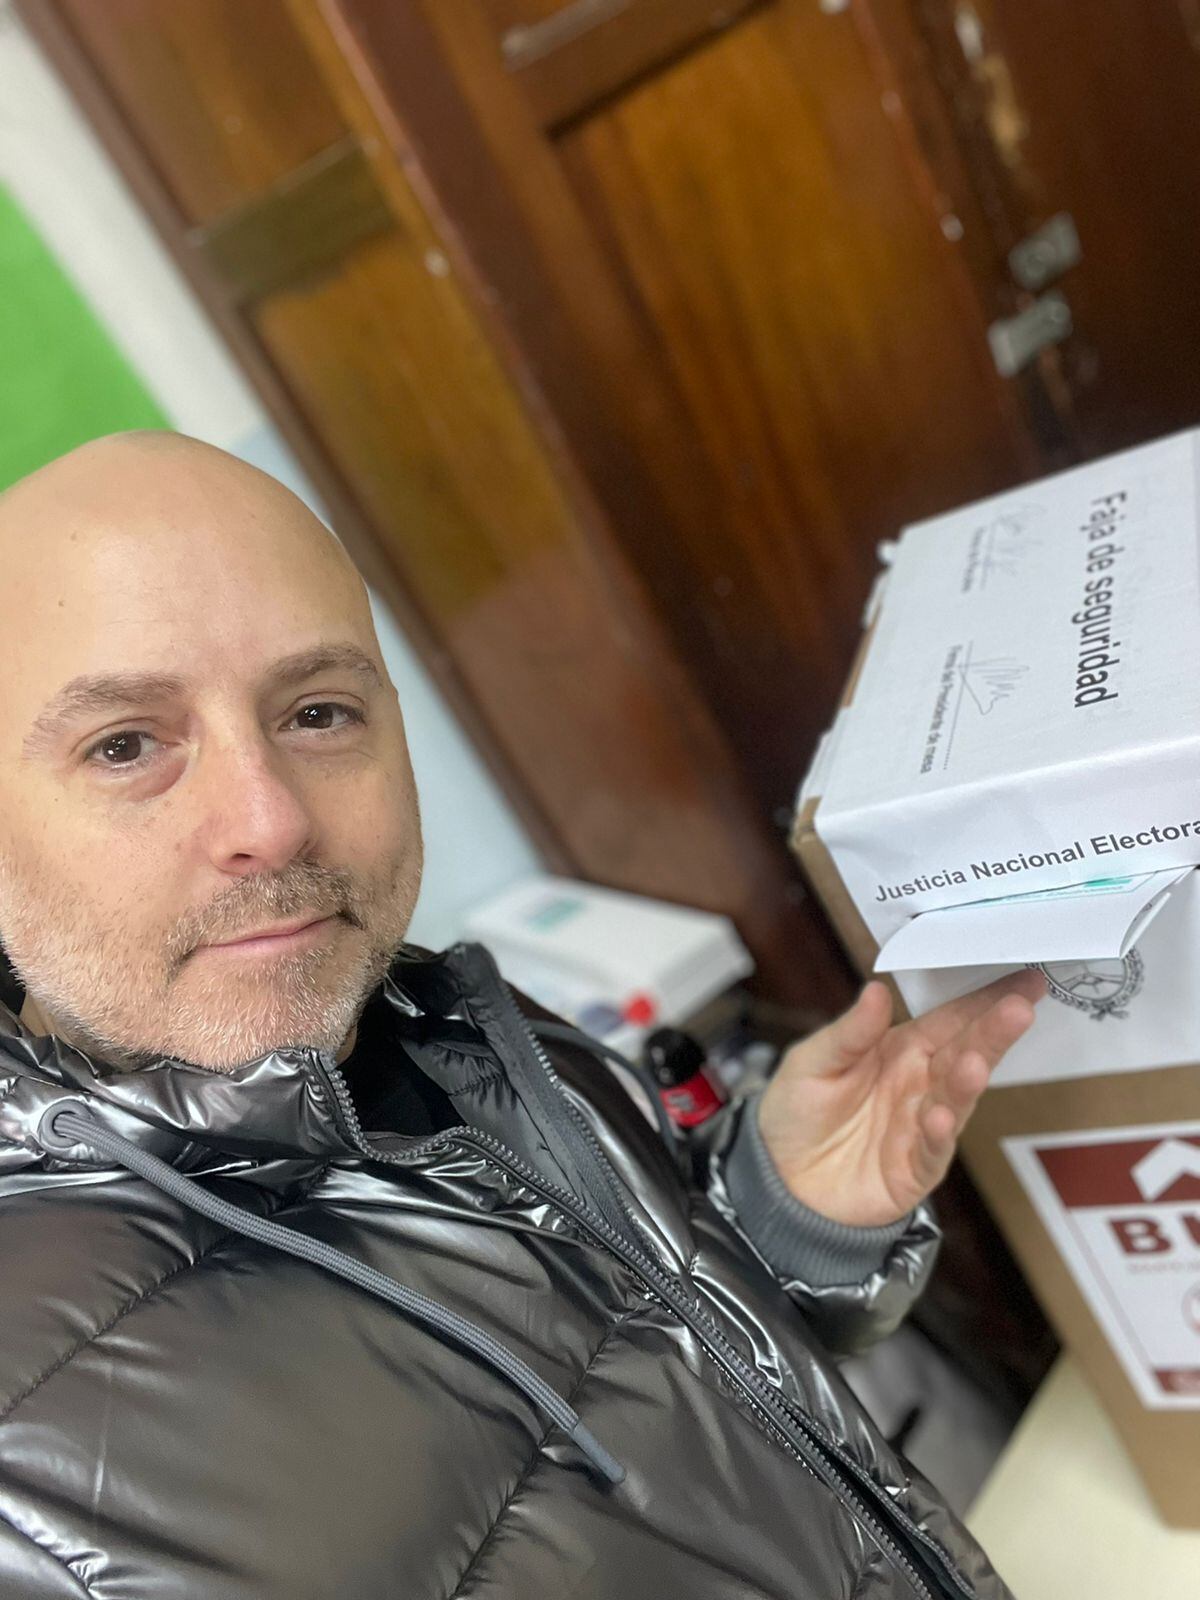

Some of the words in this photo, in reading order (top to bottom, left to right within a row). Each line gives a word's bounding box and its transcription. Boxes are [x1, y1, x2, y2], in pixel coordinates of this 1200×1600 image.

[1080, 490, 1127, 541] Faja
[1086, 544, 1126, 573] de
[1071, 577, 1121, 708] seguridad
[920, 746, 936, 774] mesa
[875, 869, 967, 902] Justicia
[969, 841, 1086, 880] Nacional
